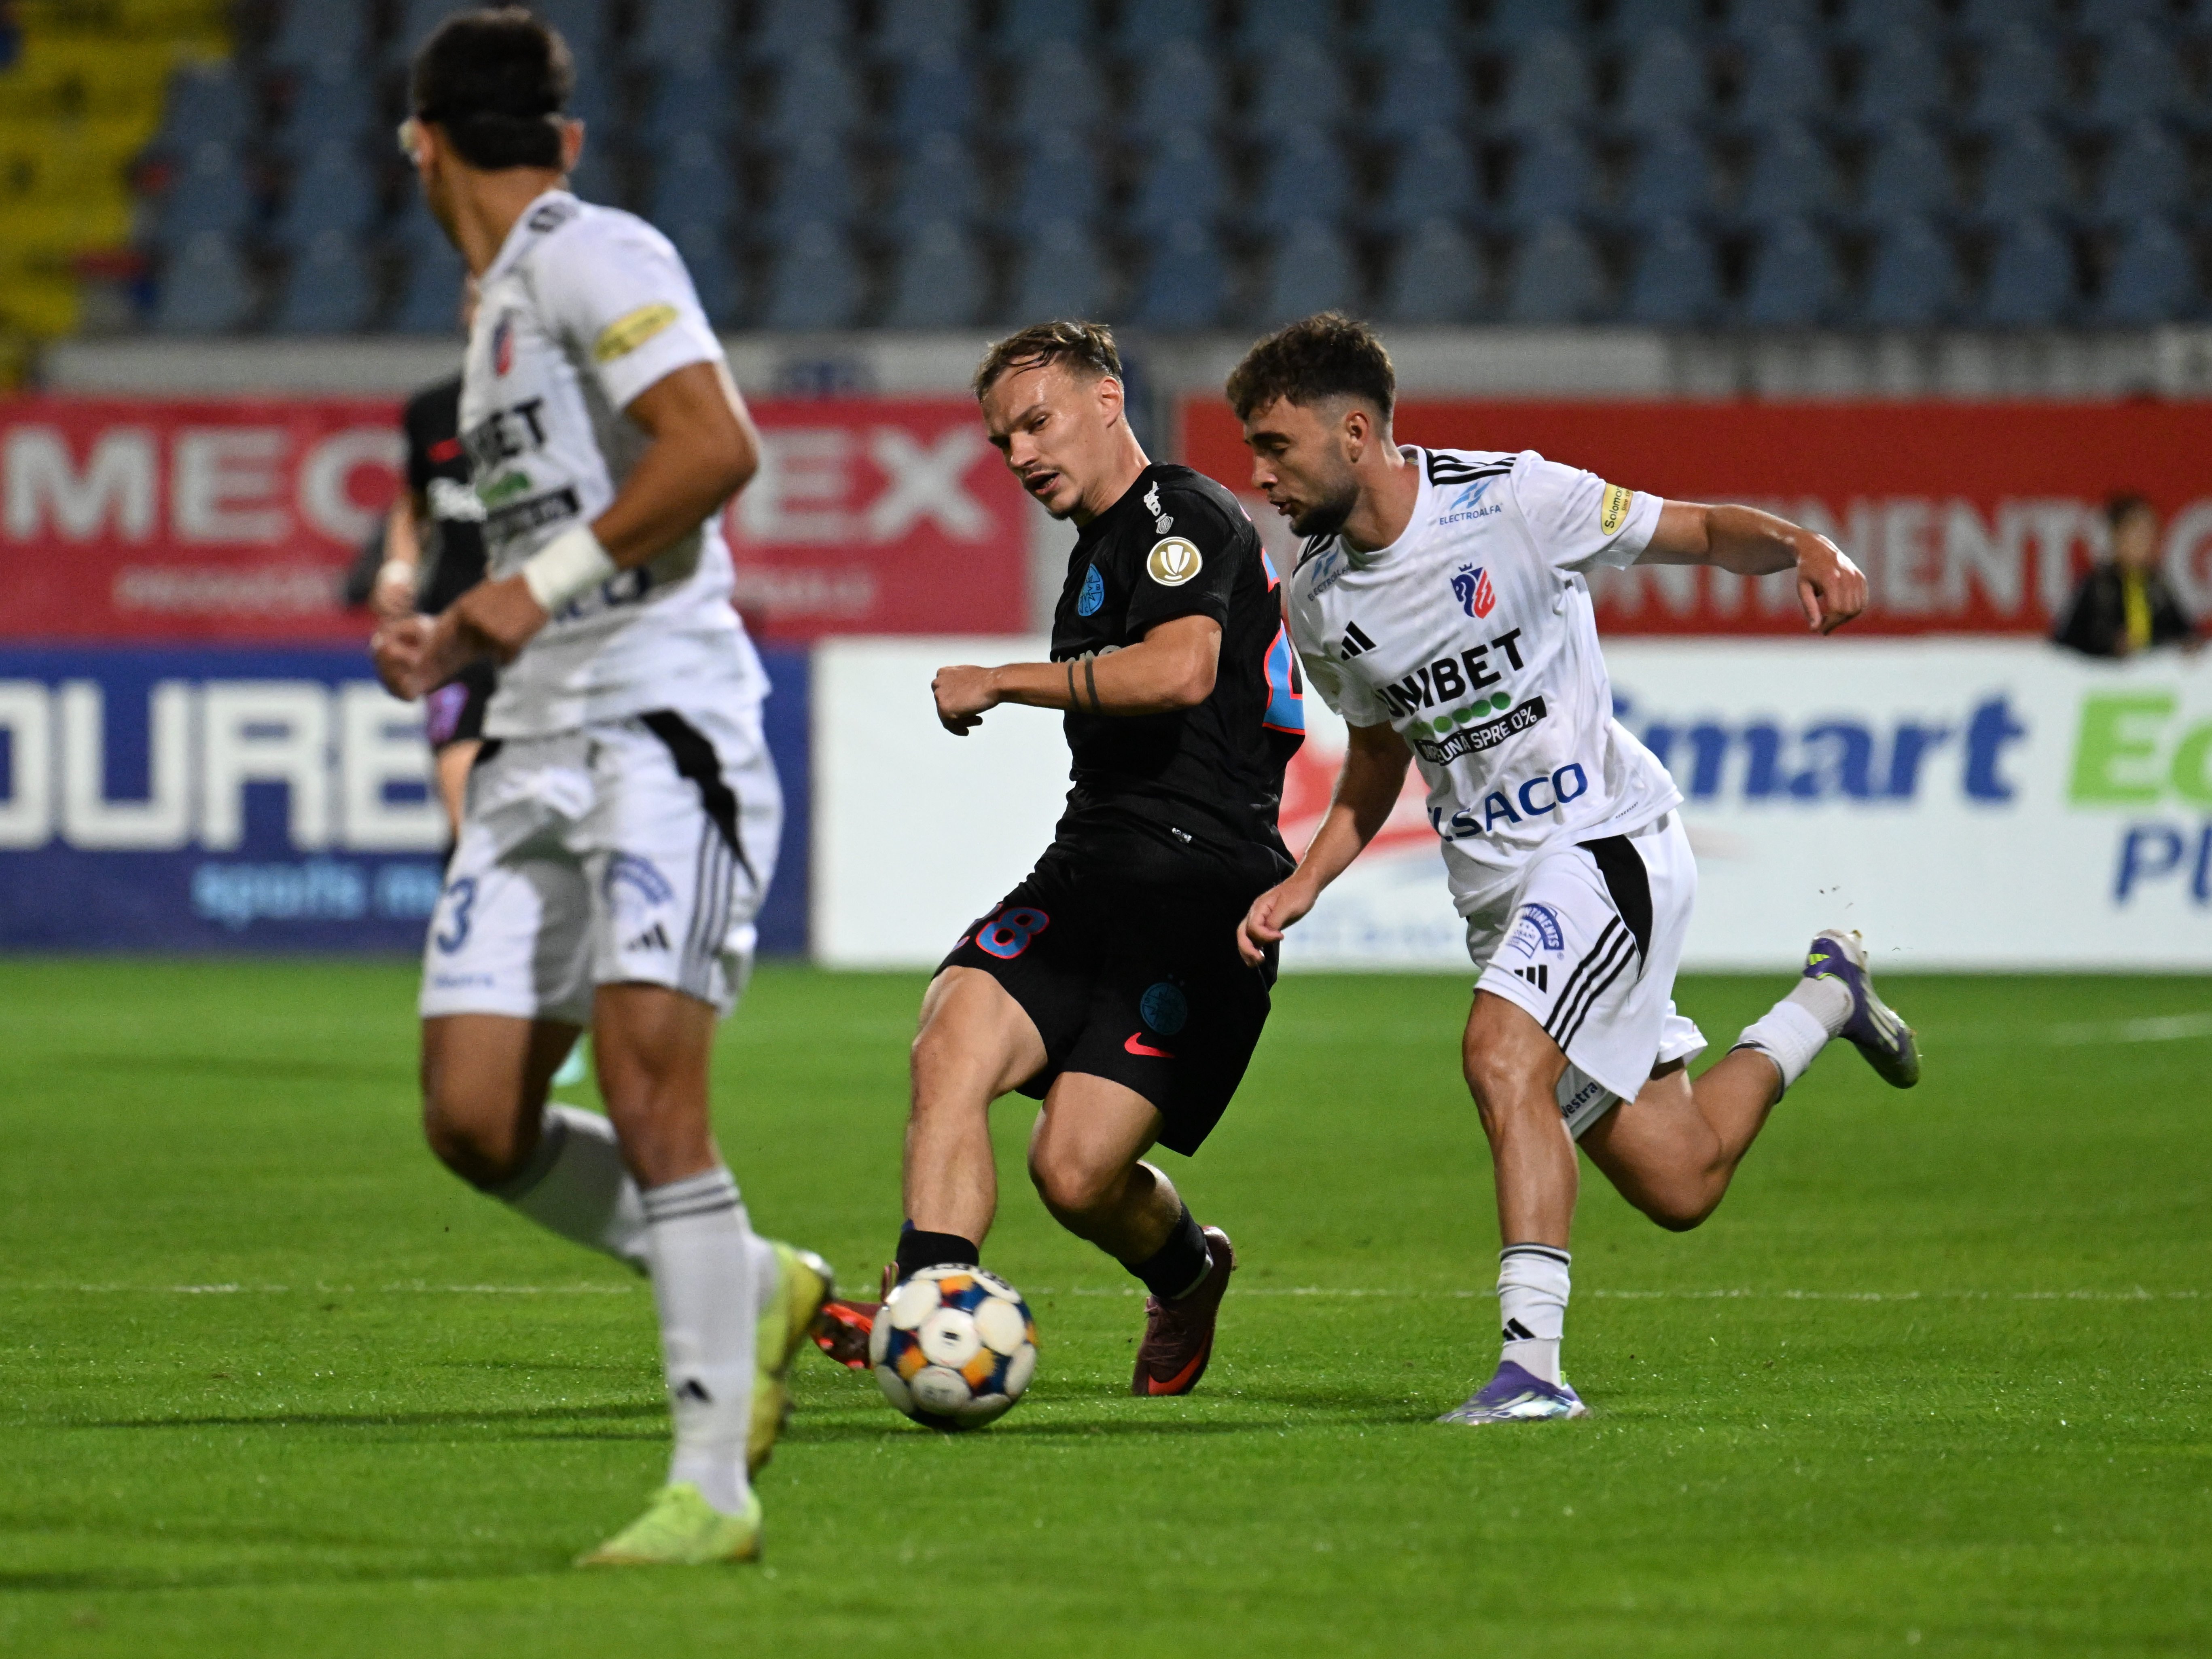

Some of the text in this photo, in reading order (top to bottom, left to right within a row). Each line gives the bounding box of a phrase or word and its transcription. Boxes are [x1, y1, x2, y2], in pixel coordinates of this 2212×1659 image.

[1439, 505, 1502, 525] ELECTROALFA
[1375, 627, 1524, 718] UNIBET
[1470, 721, 1511, 749] SPRE
[1511, 706, 1538, 729] 0%
[1427, 762, 1588, 842] LSACO
[951, 903, 1050, 959] 8
